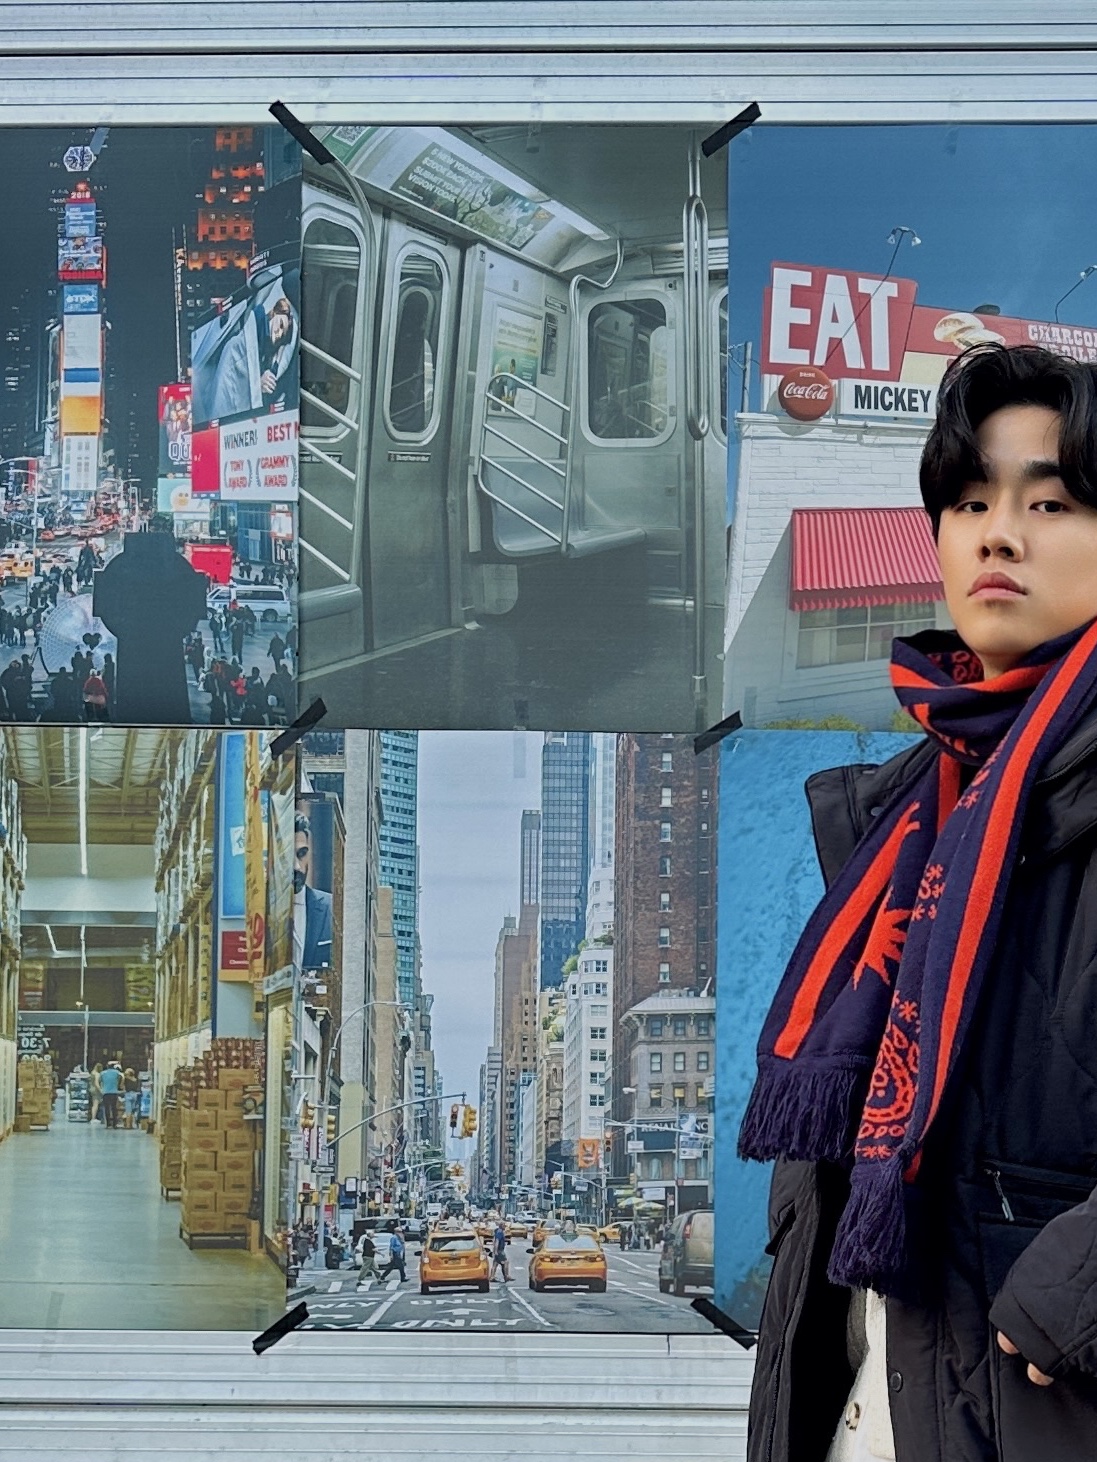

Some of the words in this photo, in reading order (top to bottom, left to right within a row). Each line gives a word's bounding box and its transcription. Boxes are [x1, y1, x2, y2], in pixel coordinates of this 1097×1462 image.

[769, 268, 898, 371] EAT
[854, 384, 932, 413] MICKEY
[267, 422, 291, 443] BEST
